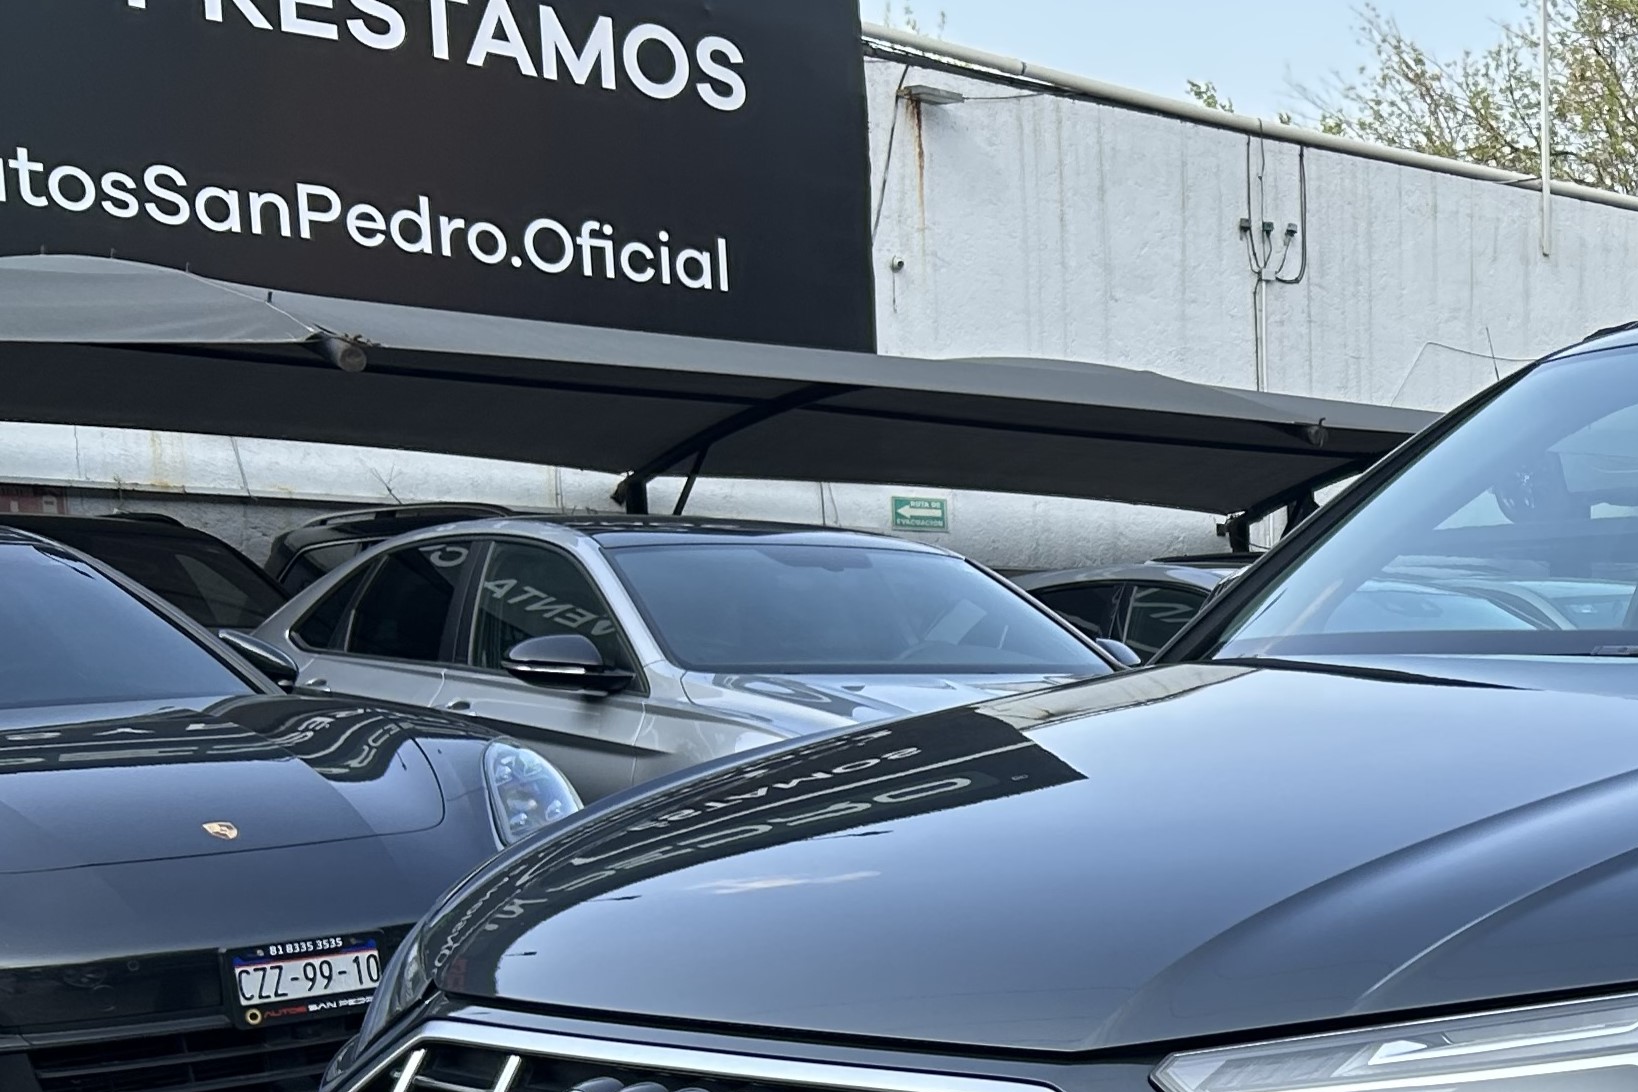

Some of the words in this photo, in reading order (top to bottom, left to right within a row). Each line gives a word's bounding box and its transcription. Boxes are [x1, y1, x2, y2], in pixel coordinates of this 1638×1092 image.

[0, 147, 729, 293] tosSanPedro.Oficial
[269, 945, 284, 956] 81
[286, 941, 314, 954] 8335
[316, 937, 343, 950] 3535
[238, 953, 381, 1001] CZZ-99-10
[264, 1005, 308, 1018] AUTOS
[308, 1001, 337, 1011] SAN
